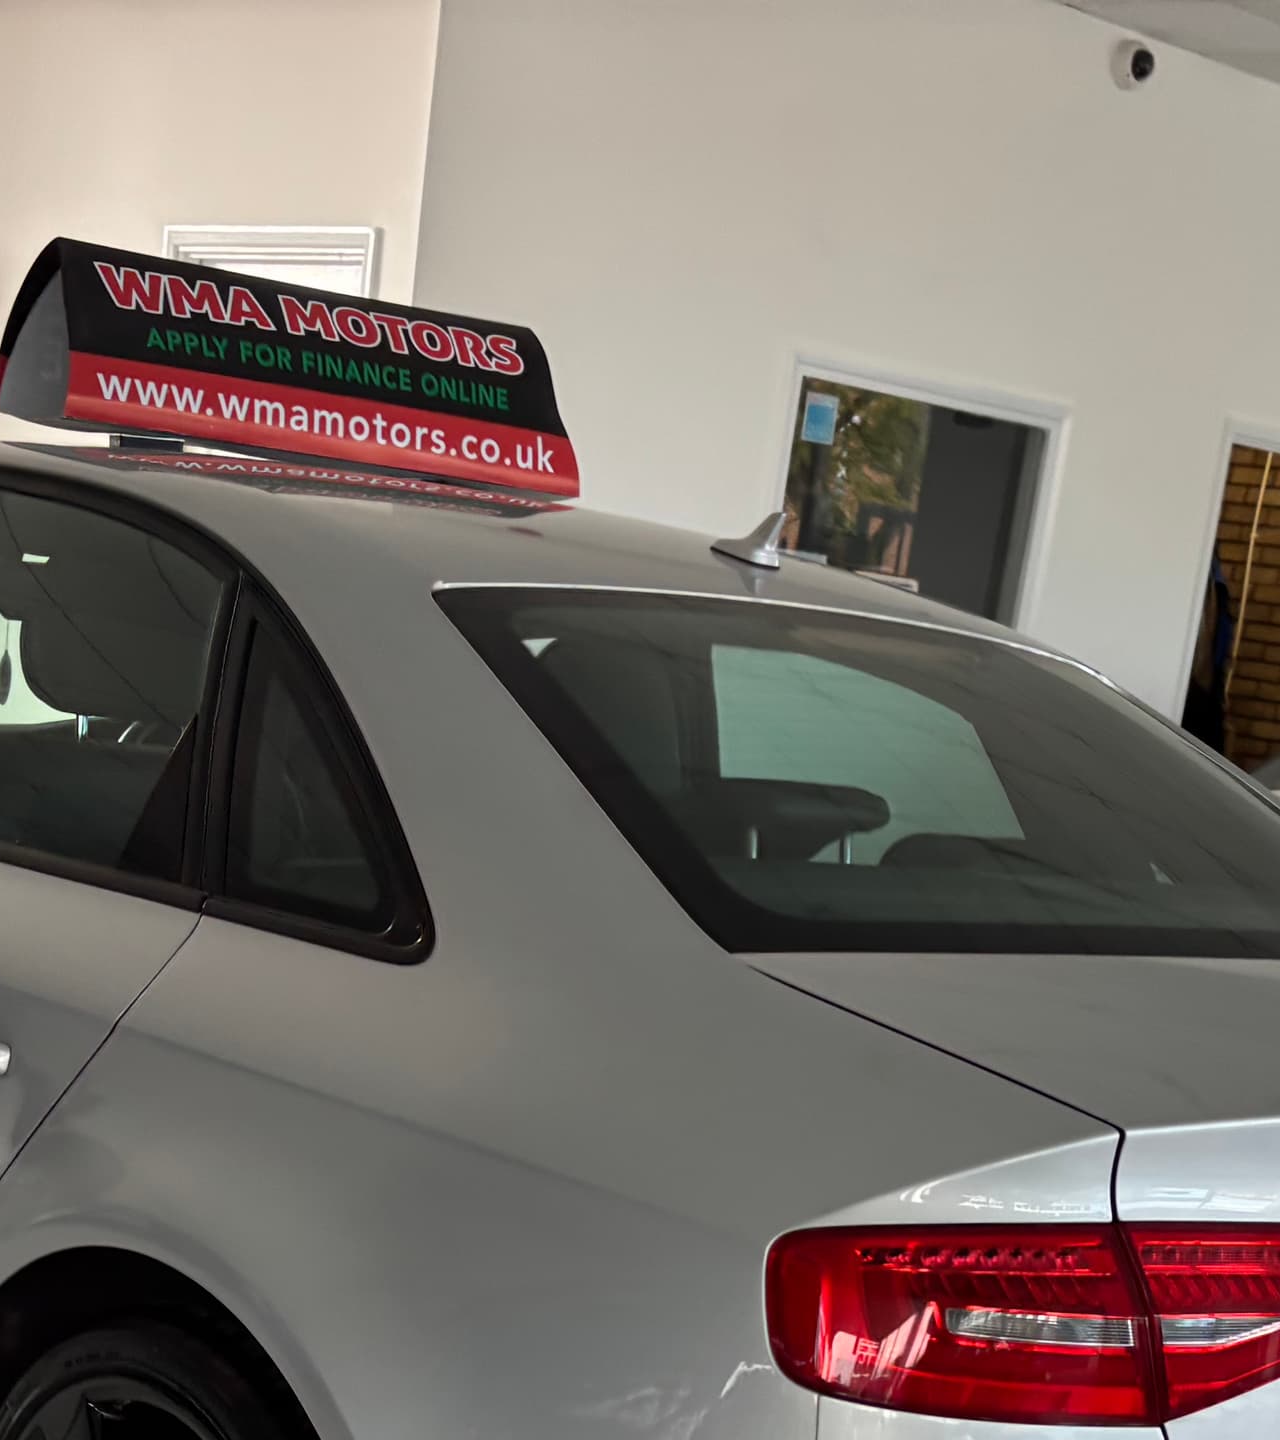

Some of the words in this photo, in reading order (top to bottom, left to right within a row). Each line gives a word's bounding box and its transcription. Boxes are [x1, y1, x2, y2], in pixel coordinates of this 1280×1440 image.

[94, 261, 277, 332] WMA
[279, 294, 525, 375] MOTORS
[147, 326, 230, 362] APPLY
[239, 340, 293, 373] FOR
[302, 350, 412, 393] FINANCE
[421, 371, 510, 411] ONLINE
[96, 371, 557, 475] www.wmamotors.co.uk
